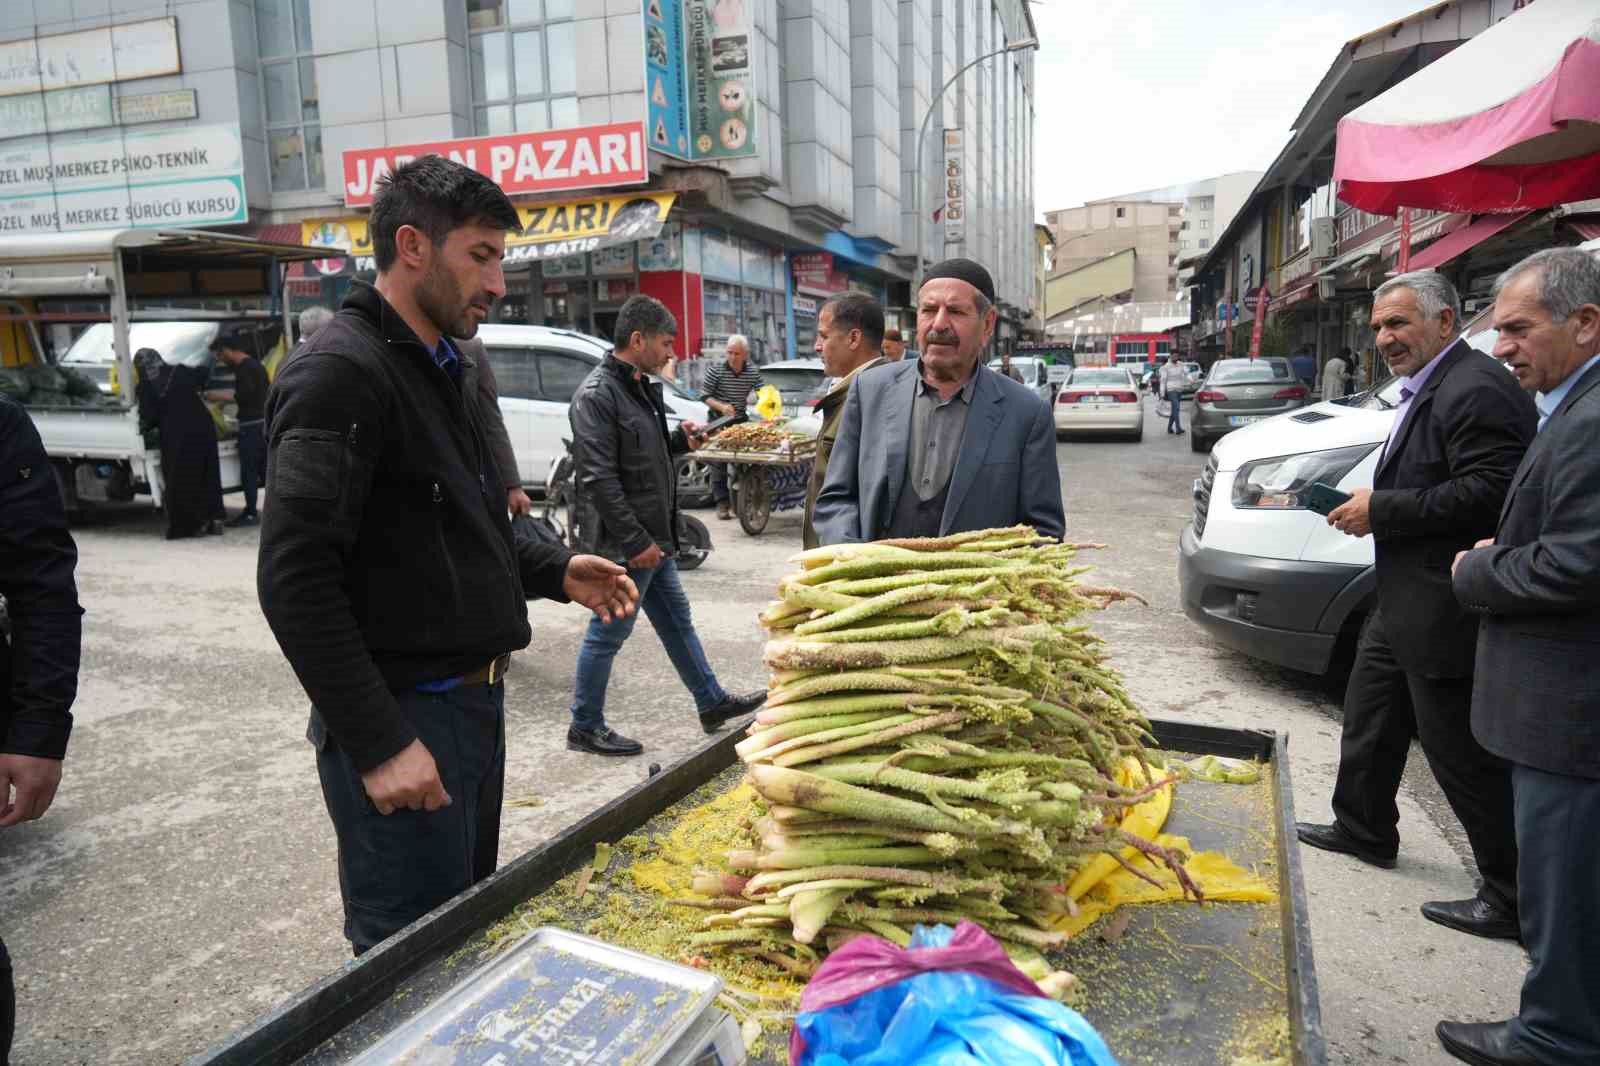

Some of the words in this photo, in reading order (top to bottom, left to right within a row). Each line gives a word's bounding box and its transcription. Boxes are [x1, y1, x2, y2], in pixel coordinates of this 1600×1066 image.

[490, 131, 641, 184] PAZARI
[0, 169, 21, 184] ZEL
[55, 160, 109, 177] MERKEZ
[65, 207, 120, 225] MERKEZ
[186, 197, 236, 215] KURSU
